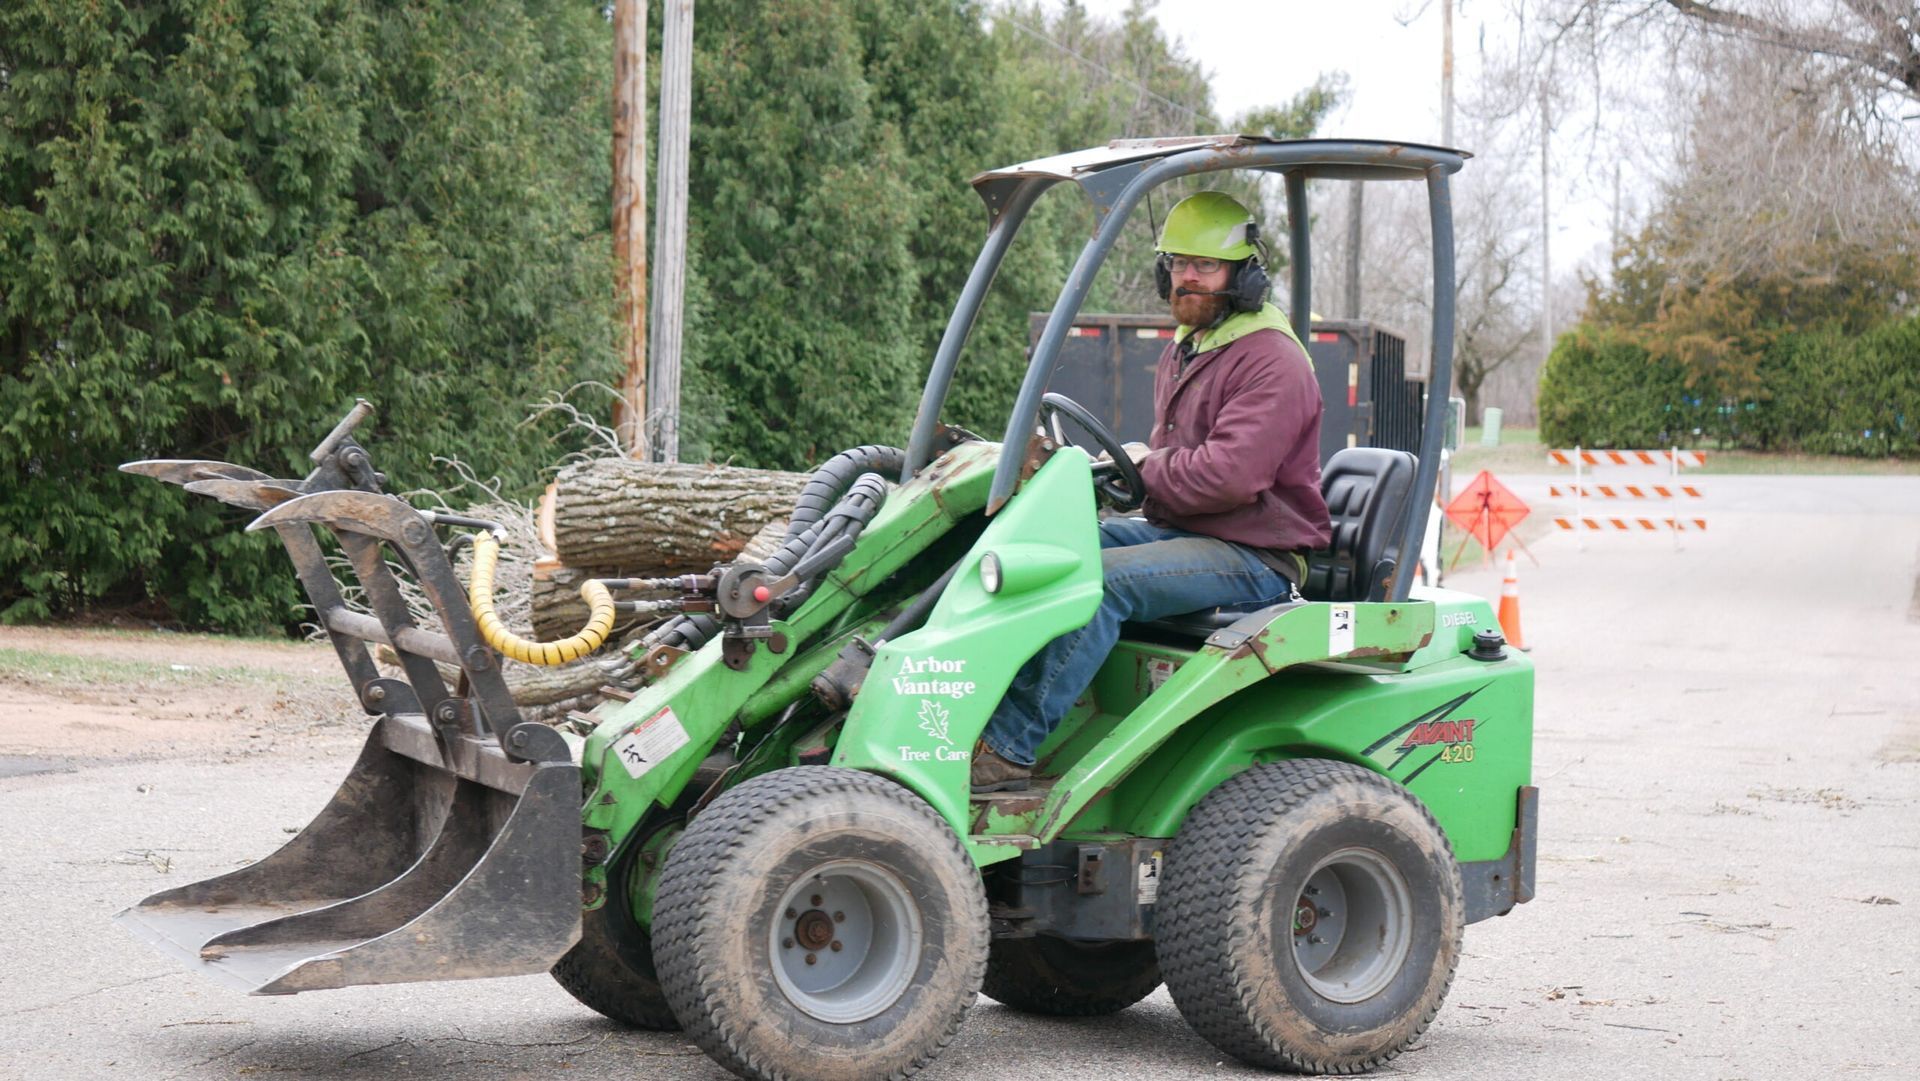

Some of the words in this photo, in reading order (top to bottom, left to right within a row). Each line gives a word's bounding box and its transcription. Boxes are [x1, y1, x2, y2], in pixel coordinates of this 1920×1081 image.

[1442, 611, 1478, 627] DIESEL
[897, 655, 966, 675] Arbor
[891, 676, 976, 699] Vantage
[1401, 719, 1476, 747] AVANT
[897, 745, 931, 761] Tree
[935, 745, 970, 761] Care
[1440, 744, 1475, 763] 420
